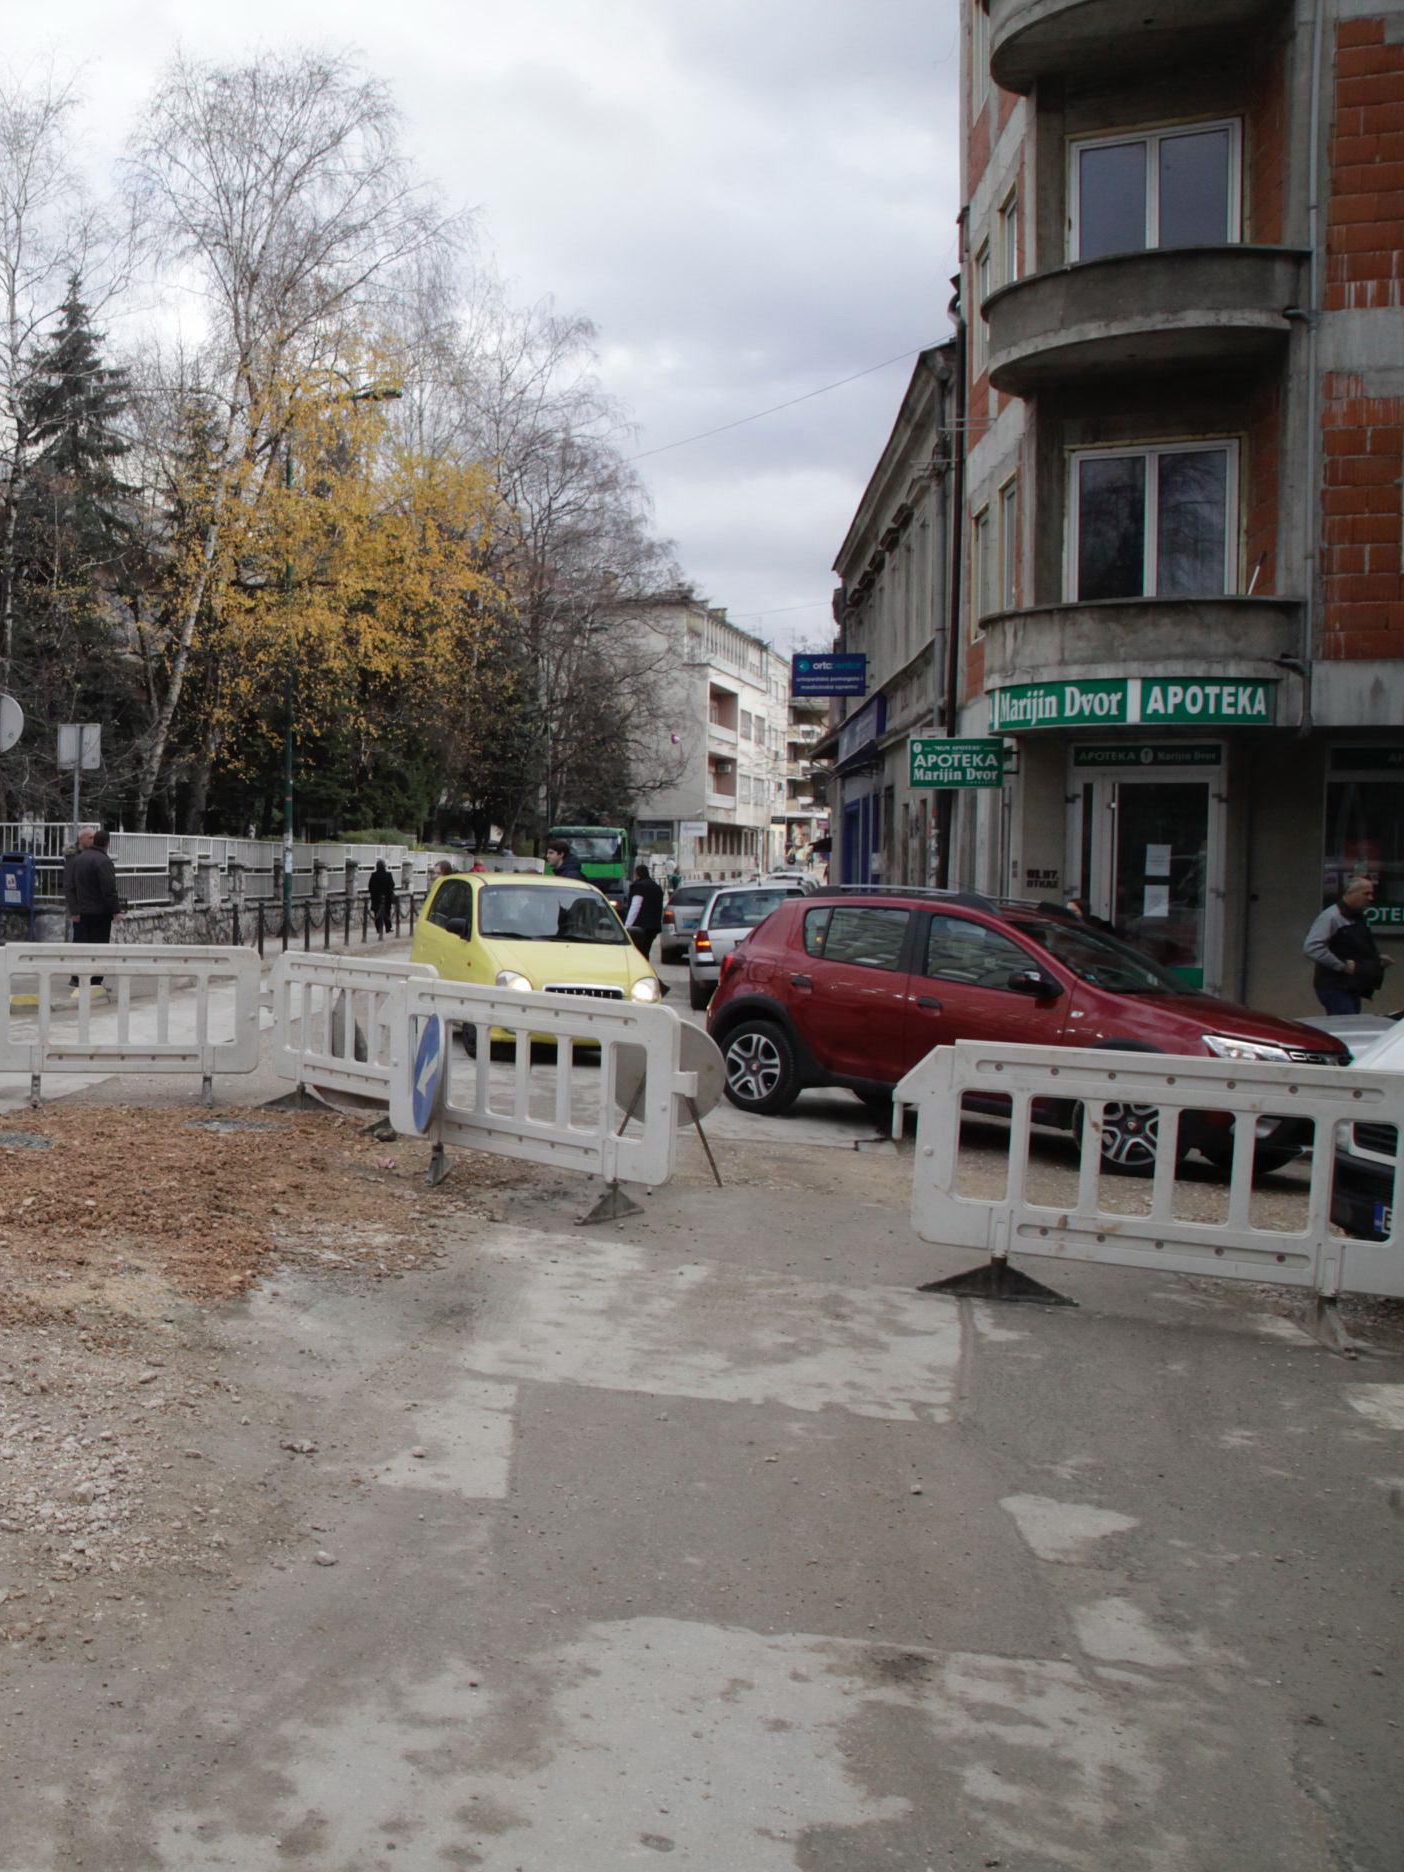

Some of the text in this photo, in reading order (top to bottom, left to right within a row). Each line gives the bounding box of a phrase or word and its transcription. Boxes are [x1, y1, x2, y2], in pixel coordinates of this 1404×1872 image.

[1000, 690, 1058, 726] Marijin
[1064, 686, 1122, 717] Dvor
[1146, 685, 1266, 715] APOTEKA
[914, 754, 998, 768] APOTEKA
[1079, 752, 1136, 761] APOTEKA
[913, 768, 998, 783] Marijin Dvor
